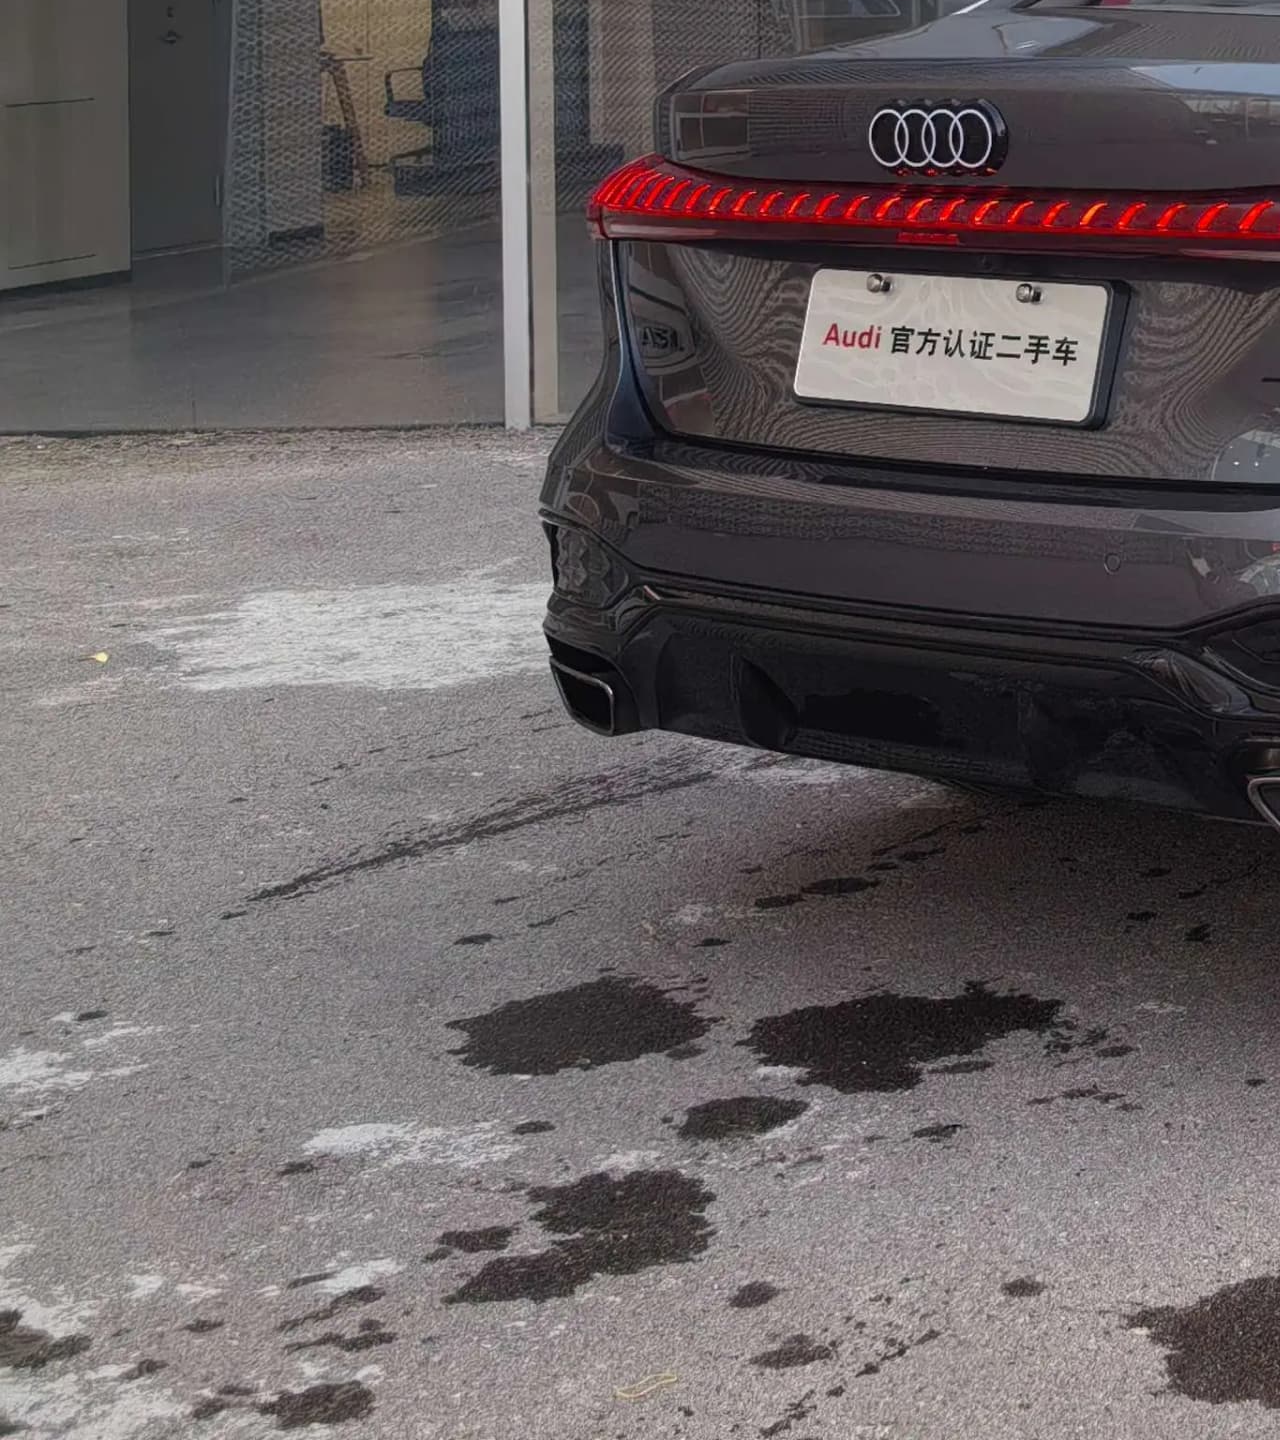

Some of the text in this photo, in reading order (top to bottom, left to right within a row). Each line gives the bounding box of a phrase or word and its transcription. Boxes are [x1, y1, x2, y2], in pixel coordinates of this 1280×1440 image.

[822, 322, 1079, 367] Audi 官方认证二手车
